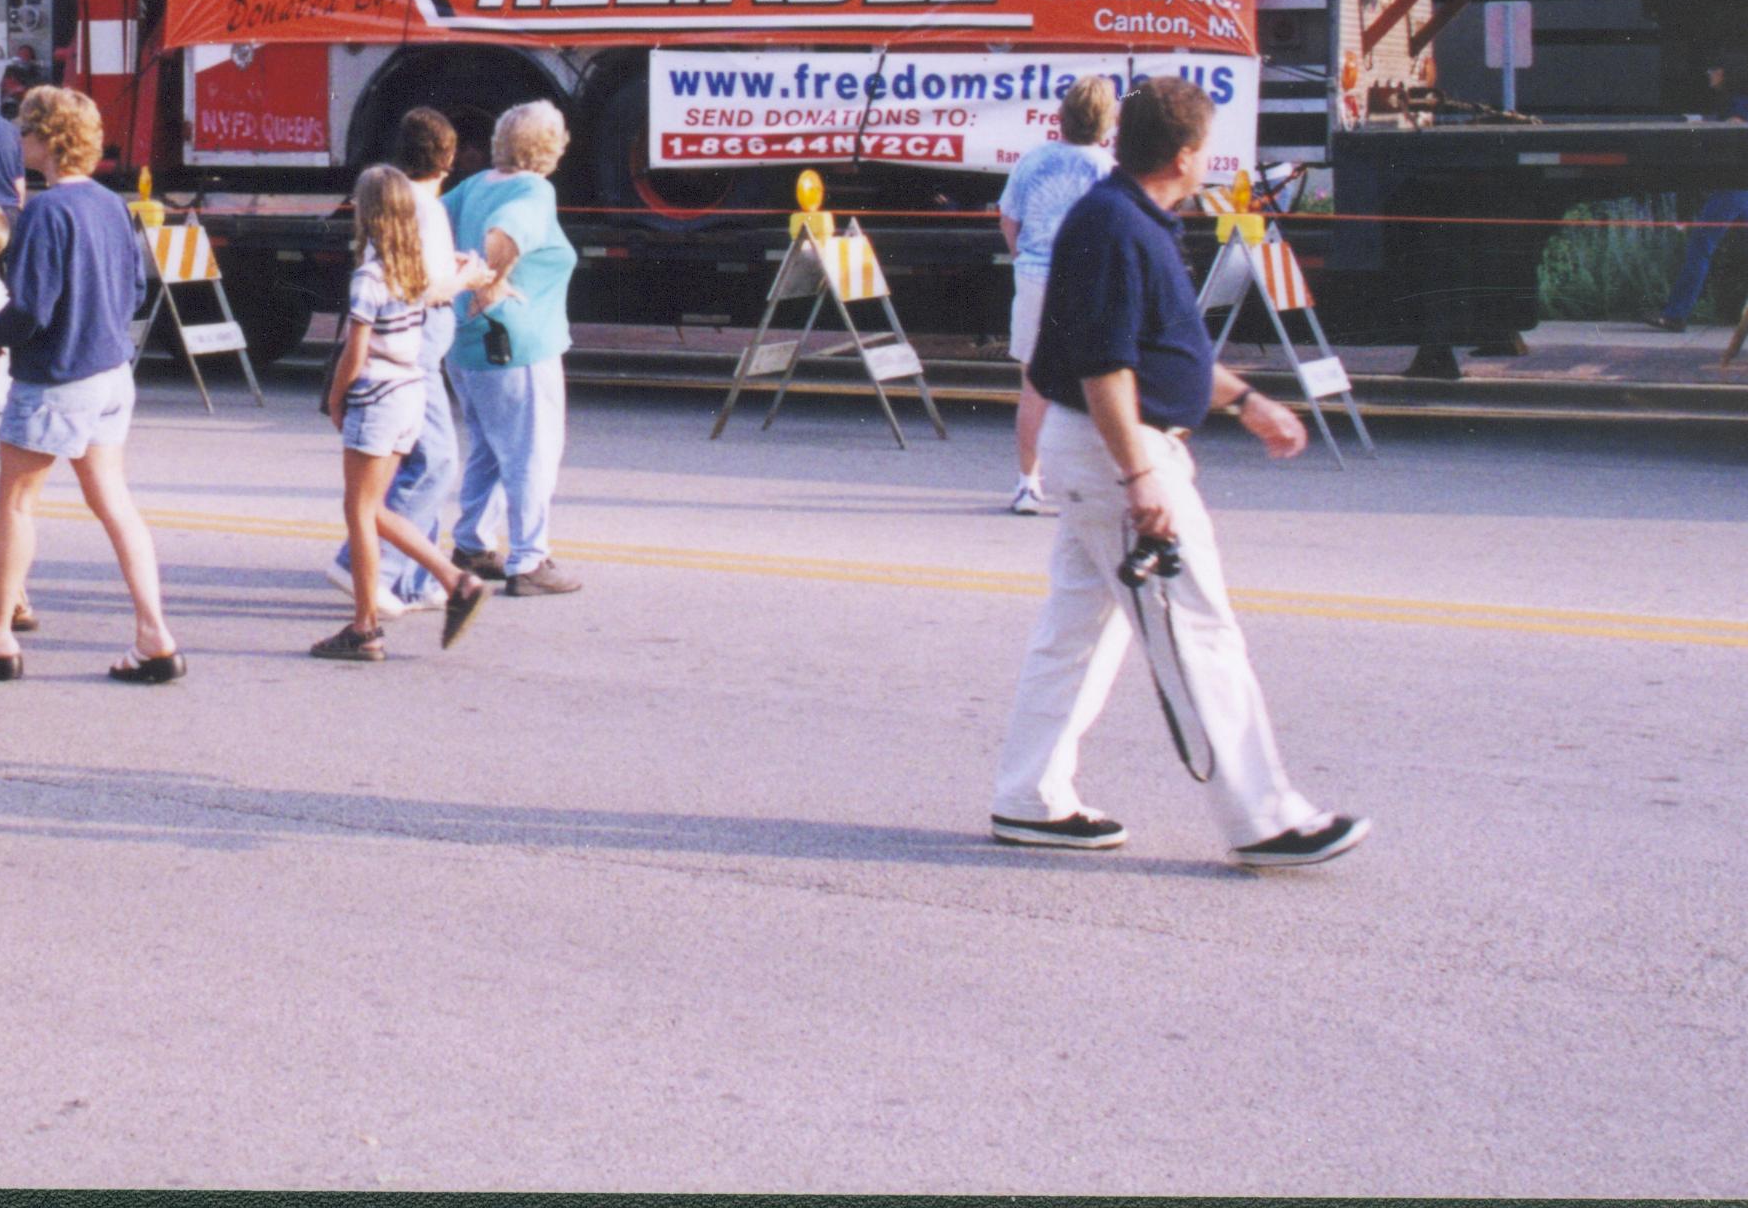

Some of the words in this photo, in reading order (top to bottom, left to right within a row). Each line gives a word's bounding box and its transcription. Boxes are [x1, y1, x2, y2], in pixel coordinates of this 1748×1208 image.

[1093, 7, 1196, 38] Canton,
[261, 111, 326, 147] QUEENS
[684, 108, 753, 127] SEND
[764, 108, 921, 128] DONATIONS
[934, 108, 977, 128] TO:
[668, 134, 956, 158] 1-866-44NY2CA
